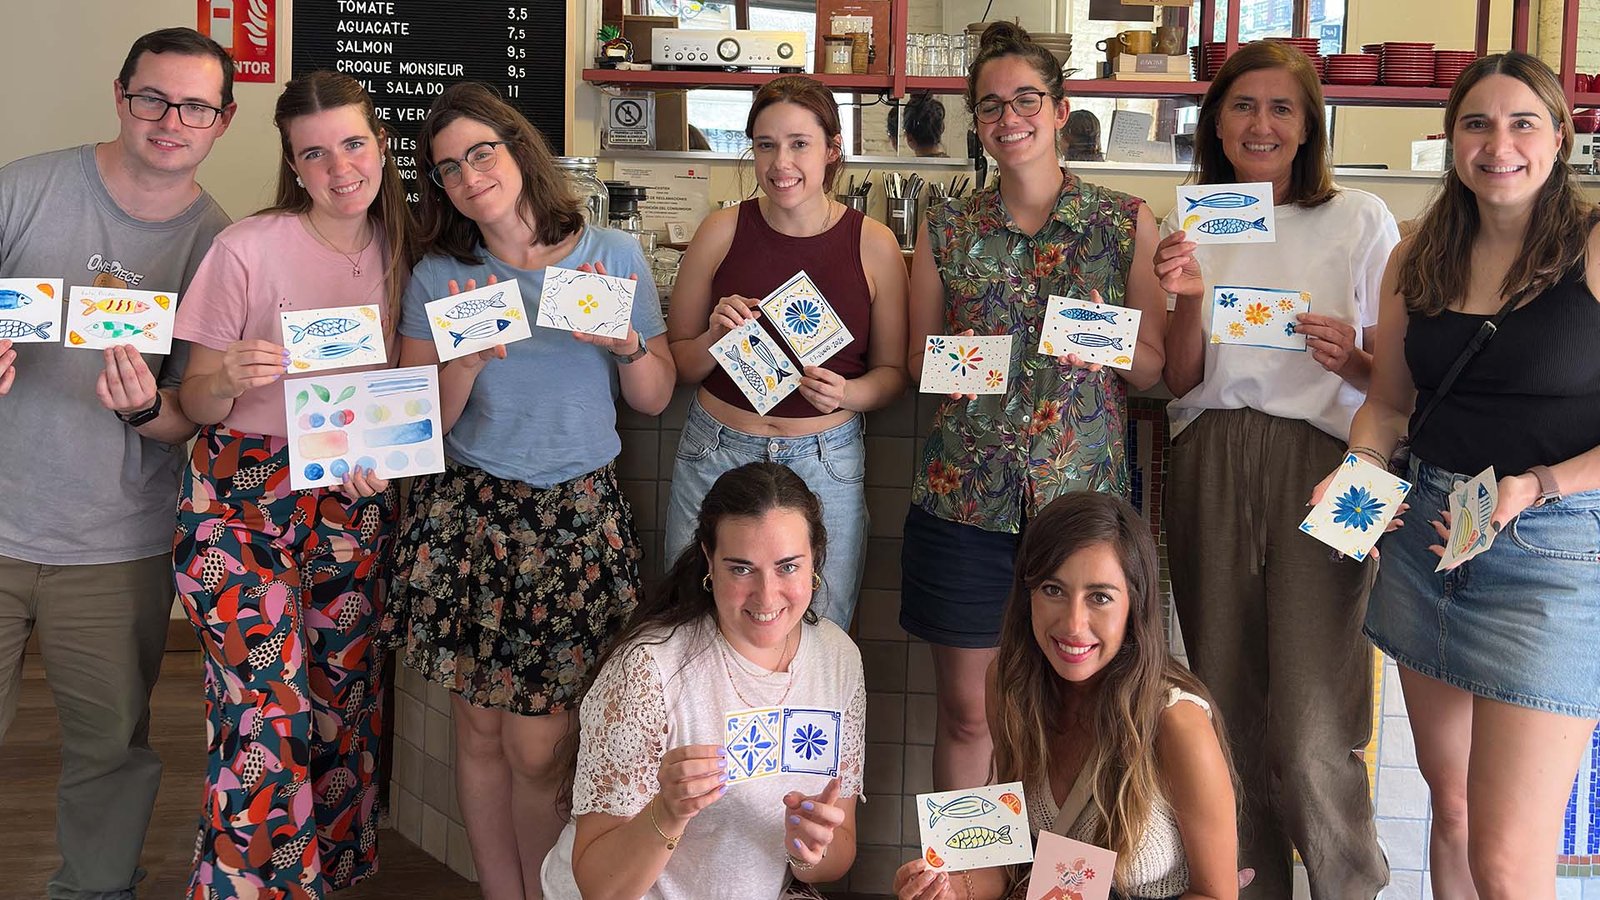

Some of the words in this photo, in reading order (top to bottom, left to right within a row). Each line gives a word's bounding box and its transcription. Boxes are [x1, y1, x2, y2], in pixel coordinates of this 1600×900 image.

[337, 0, 395, 15] TOMATE
[507, 7, 528, 20] 3,5
[336, 19, 410, 35] AGUACATE
[507, 26, 526, 40] 7,5
[336, 40, 393, 54] SALMON
[507, 45, 526, 60] 9,5
[233, 60, 270, 75] NTOR
[336, 59, 392, 74] CROQUE
[399, 61, 464, 76] MONSIEUR
[507, 65, 526, 79] 9,5
[386, 81, 444, 95] SALADO
[507, 84, 519, 98] 11
[375, 107, 391, 120] DE
[399, 169, 418, 180] NGO
